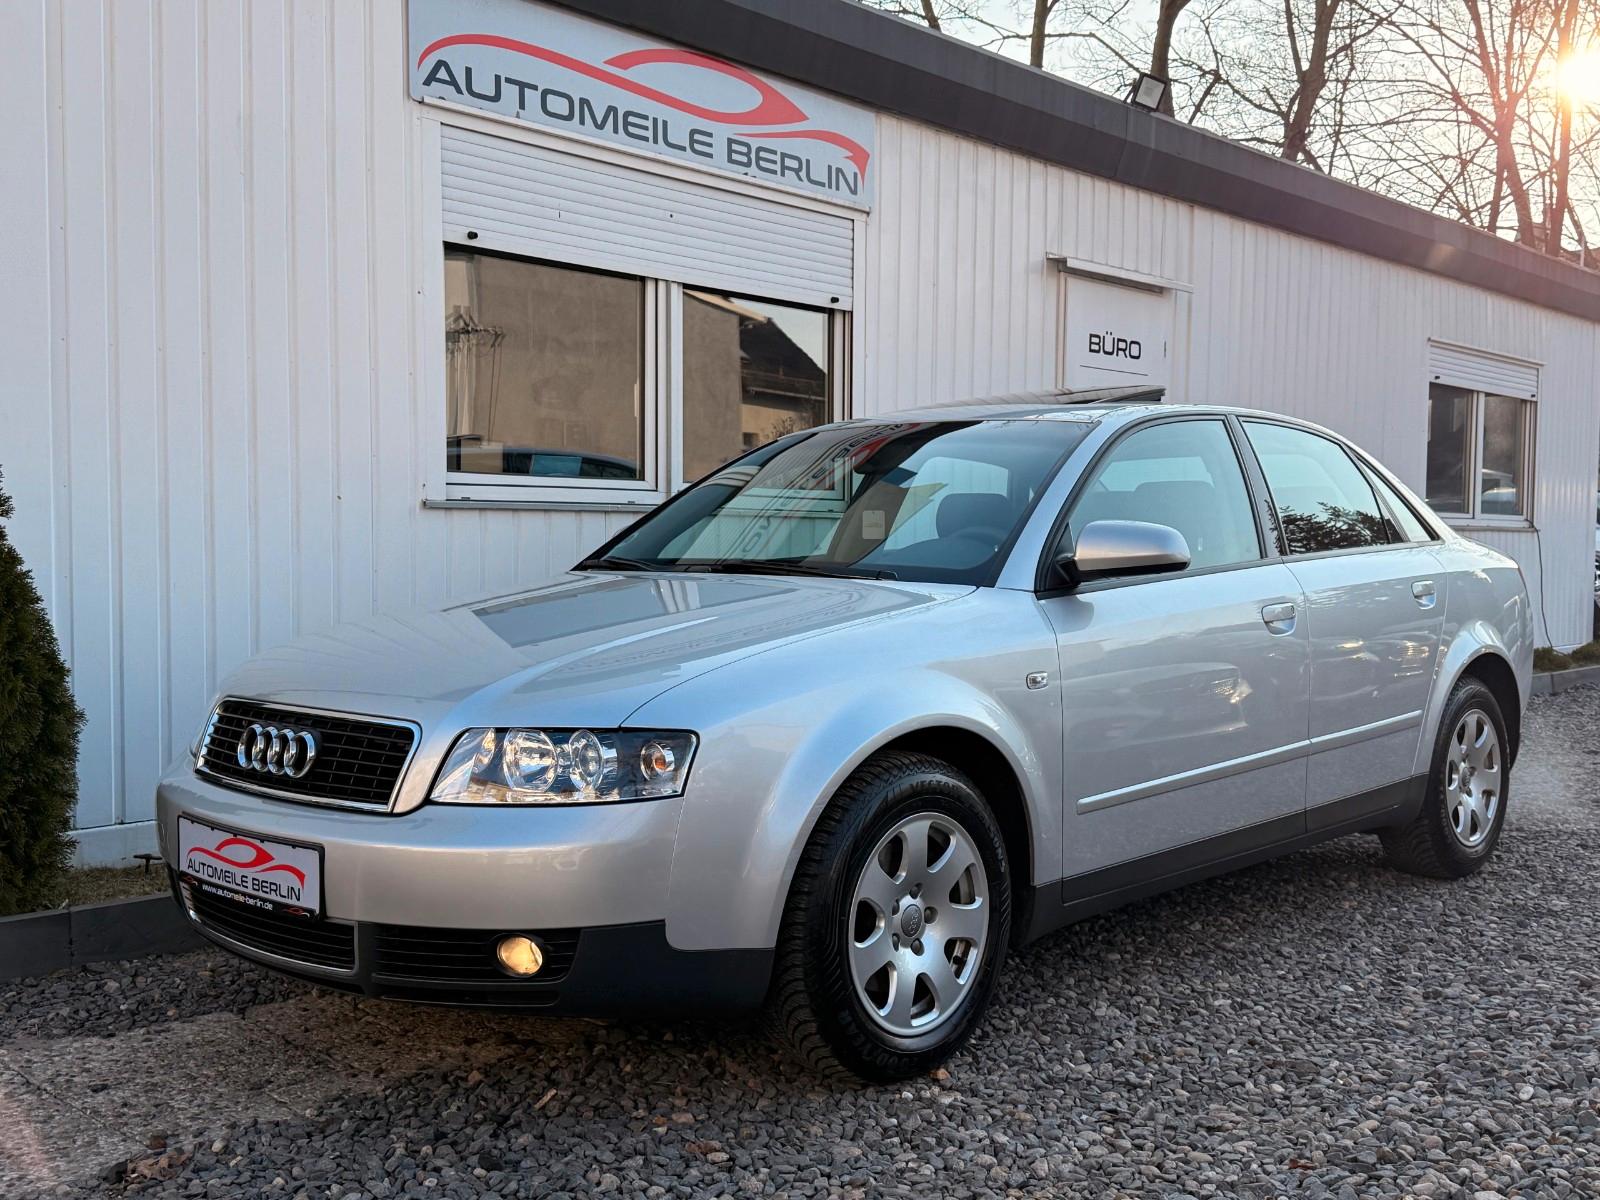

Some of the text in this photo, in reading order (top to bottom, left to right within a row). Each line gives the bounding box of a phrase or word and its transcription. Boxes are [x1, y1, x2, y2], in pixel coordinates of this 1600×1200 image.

[422, 59, 858, 196] AUTOMEILE BERLIN
[1088, 331, 1141, 360] BÜRO
[187, 858, 301, 902] AUTOMEILE BERLIN
[202, 884, 273, 911] www.automeile-berlin.de
